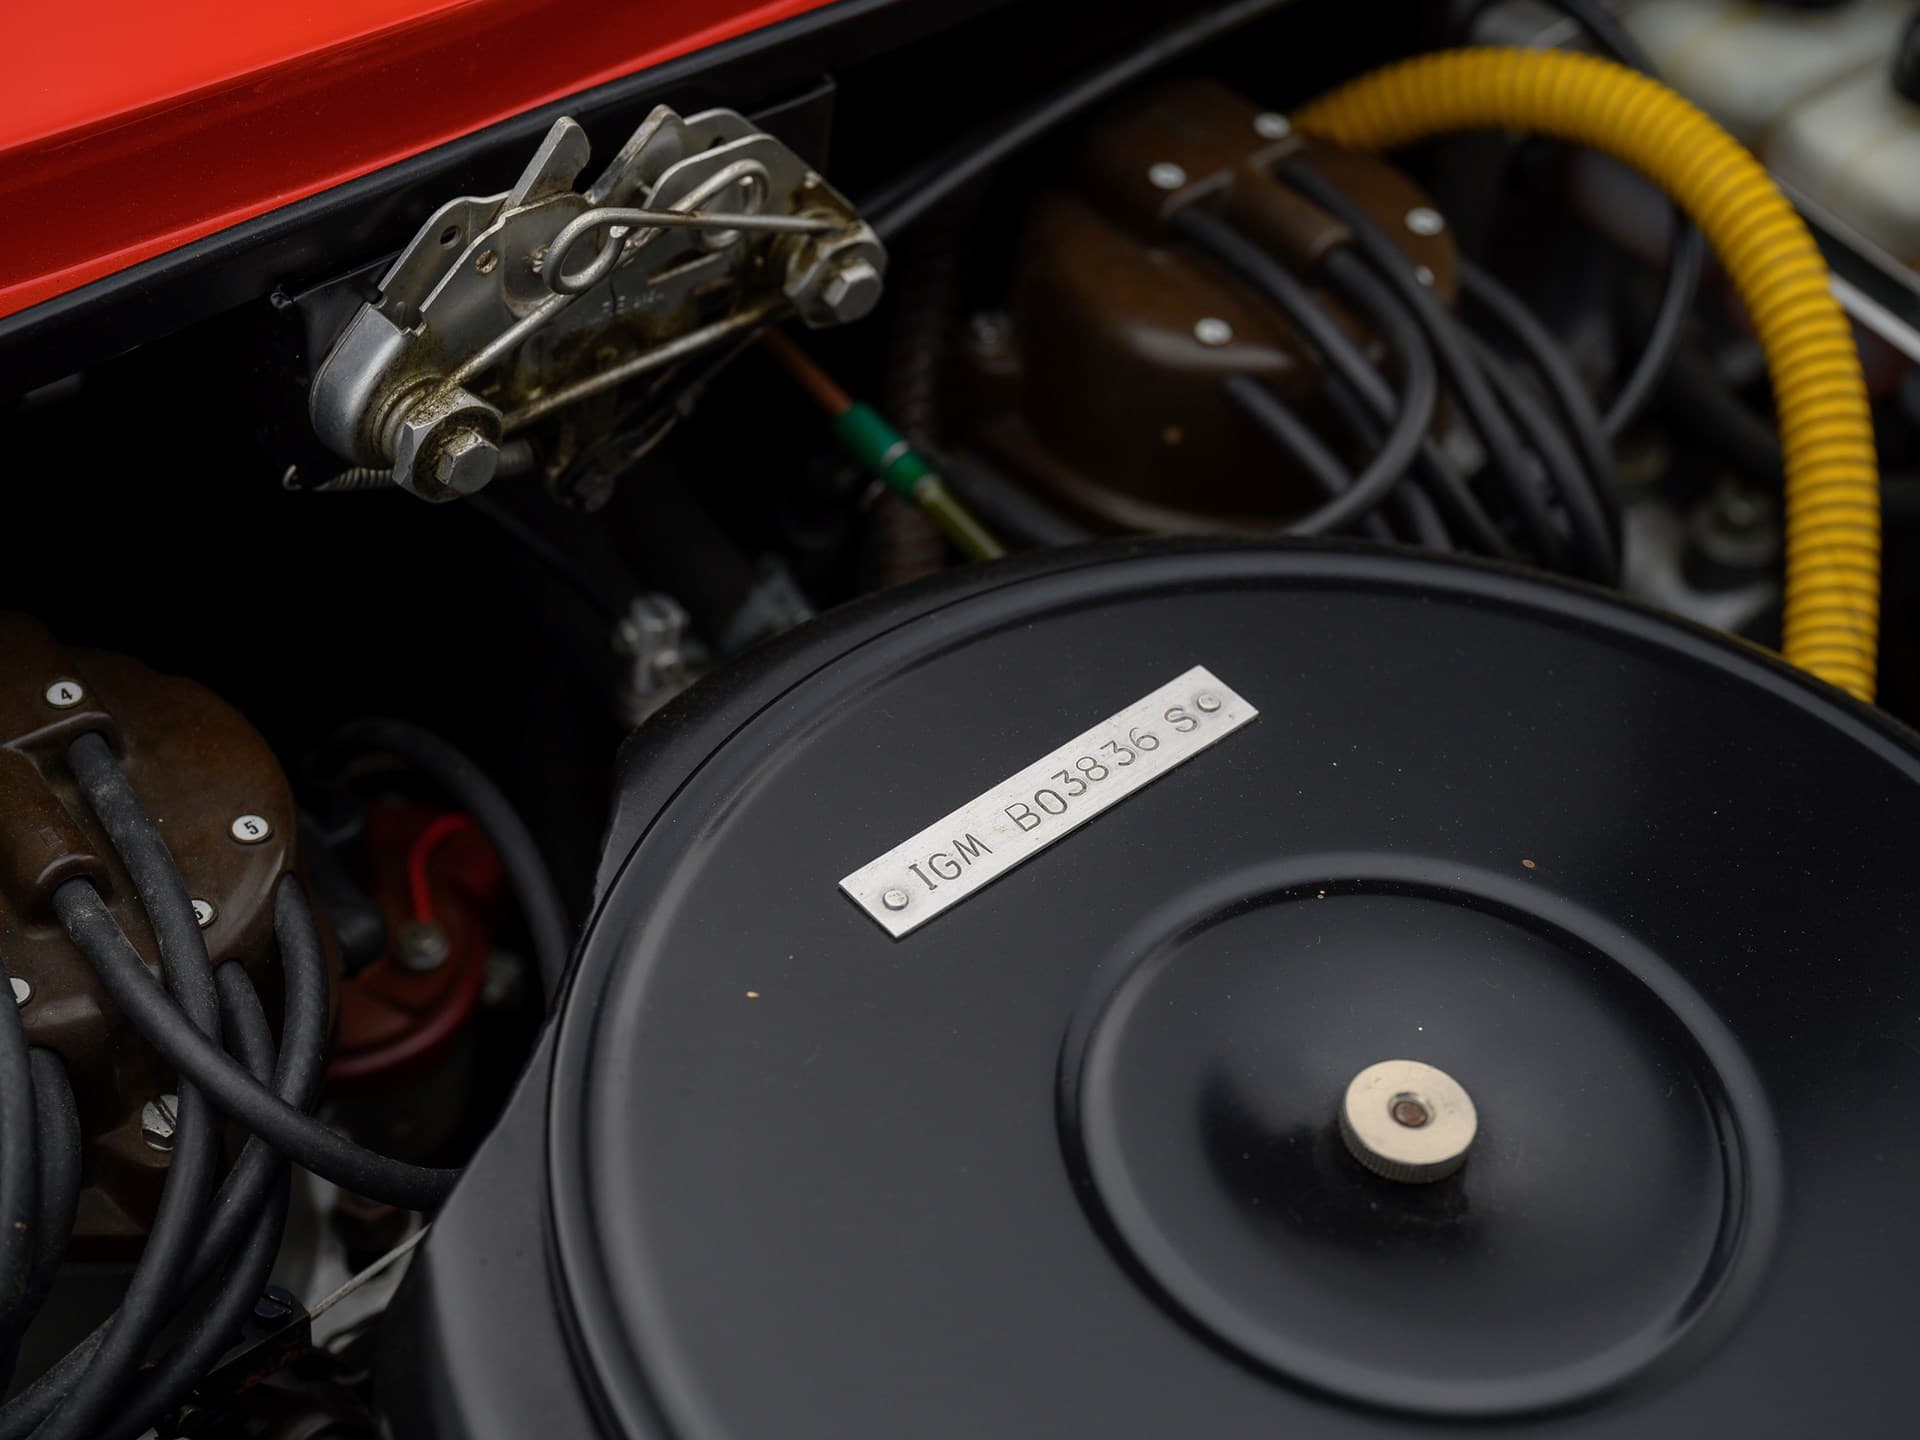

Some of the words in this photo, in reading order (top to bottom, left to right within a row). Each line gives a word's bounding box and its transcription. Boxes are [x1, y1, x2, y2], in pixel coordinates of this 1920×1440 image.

[60, 687, 73, 701] 4
[908, 832, 993, 891] IGM
[1163, 706, 1199, 734] S
[243, 820, 260, 836] 5
